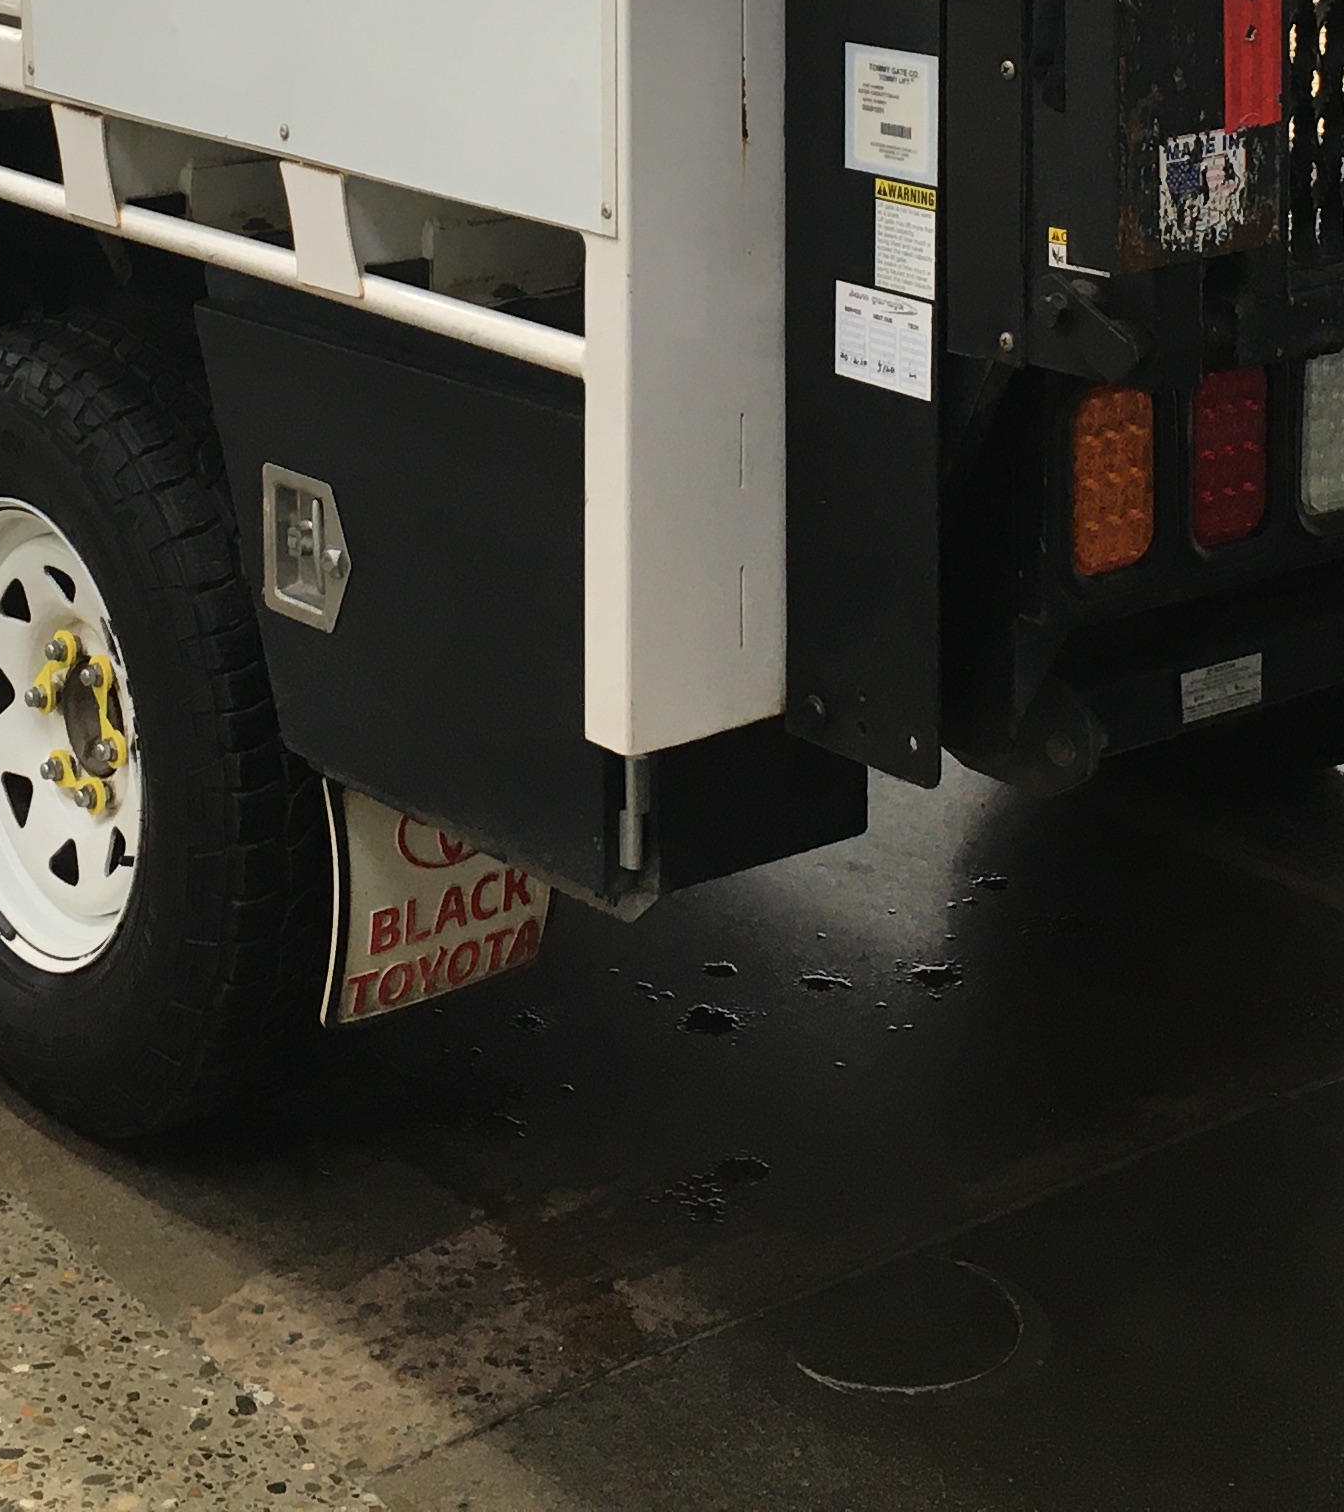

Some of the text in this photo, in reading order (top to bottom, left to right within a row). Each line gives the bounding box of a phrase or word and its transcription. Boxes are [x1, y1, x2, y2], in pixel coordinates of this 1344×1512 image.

[1165, 135, 1216, 161] MAE
[888, 183, 935, 207] WARNING
[369, 868, 532, 956] BLACK
[347, 919, 541, 1014] TOYOTA
